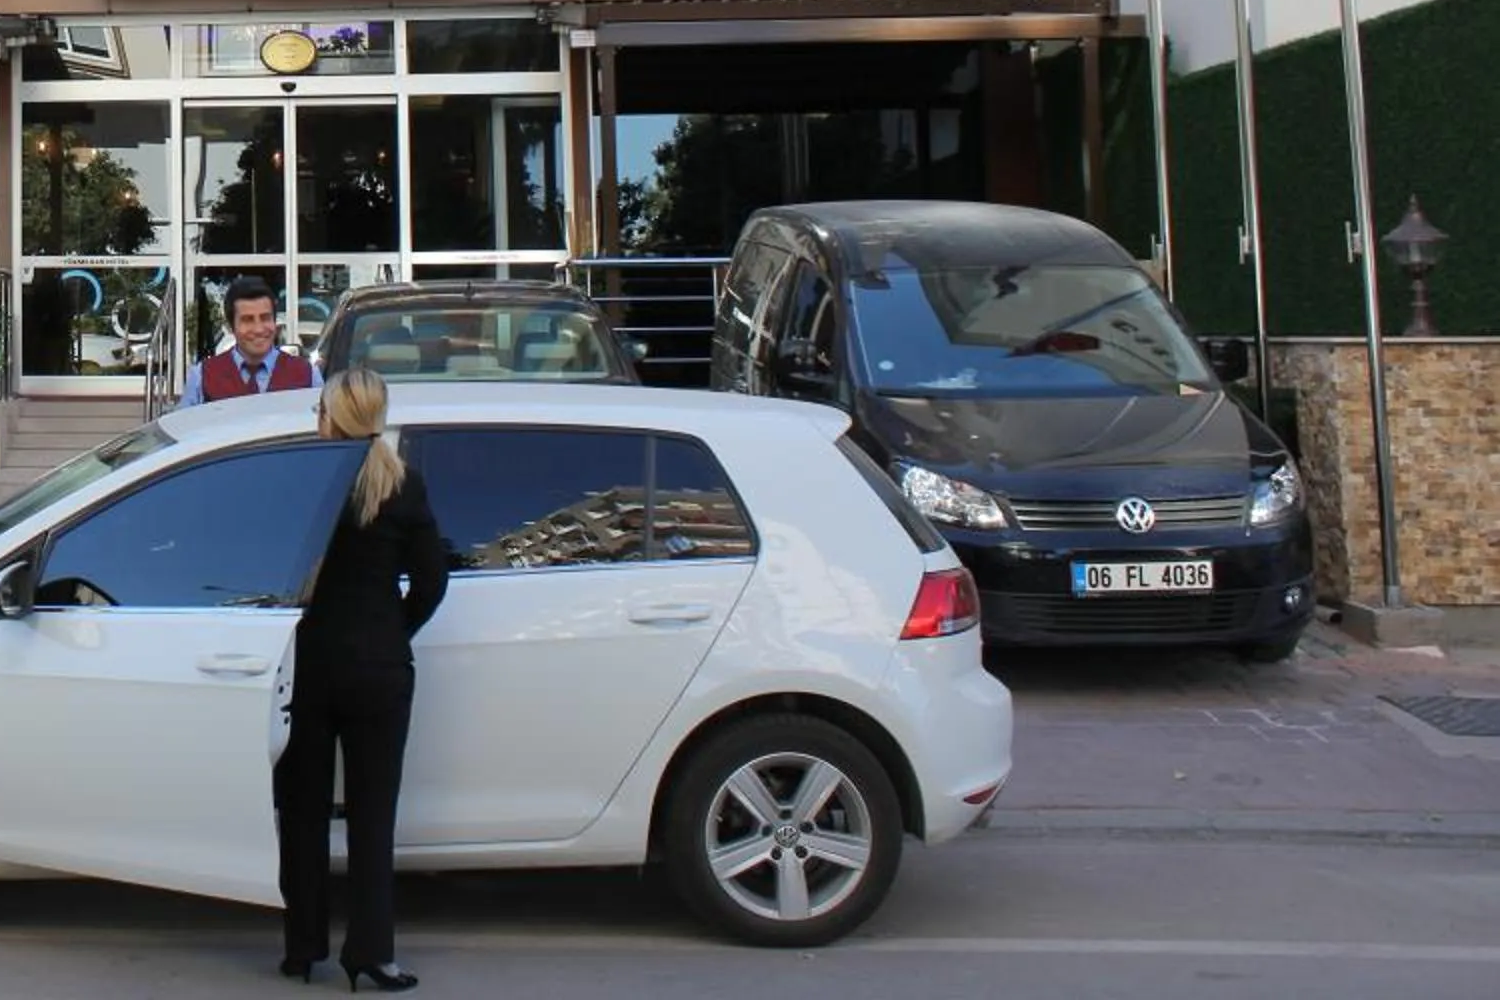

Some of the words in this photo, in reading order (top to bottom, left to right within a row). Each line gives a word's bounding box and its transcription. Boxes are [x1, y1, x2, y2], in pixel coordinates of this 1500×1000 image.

[1088, 566, 1112, 588] 06
[1125, 565, 1150, 588] FL
[1161, 564, 1209, 587] 4036
